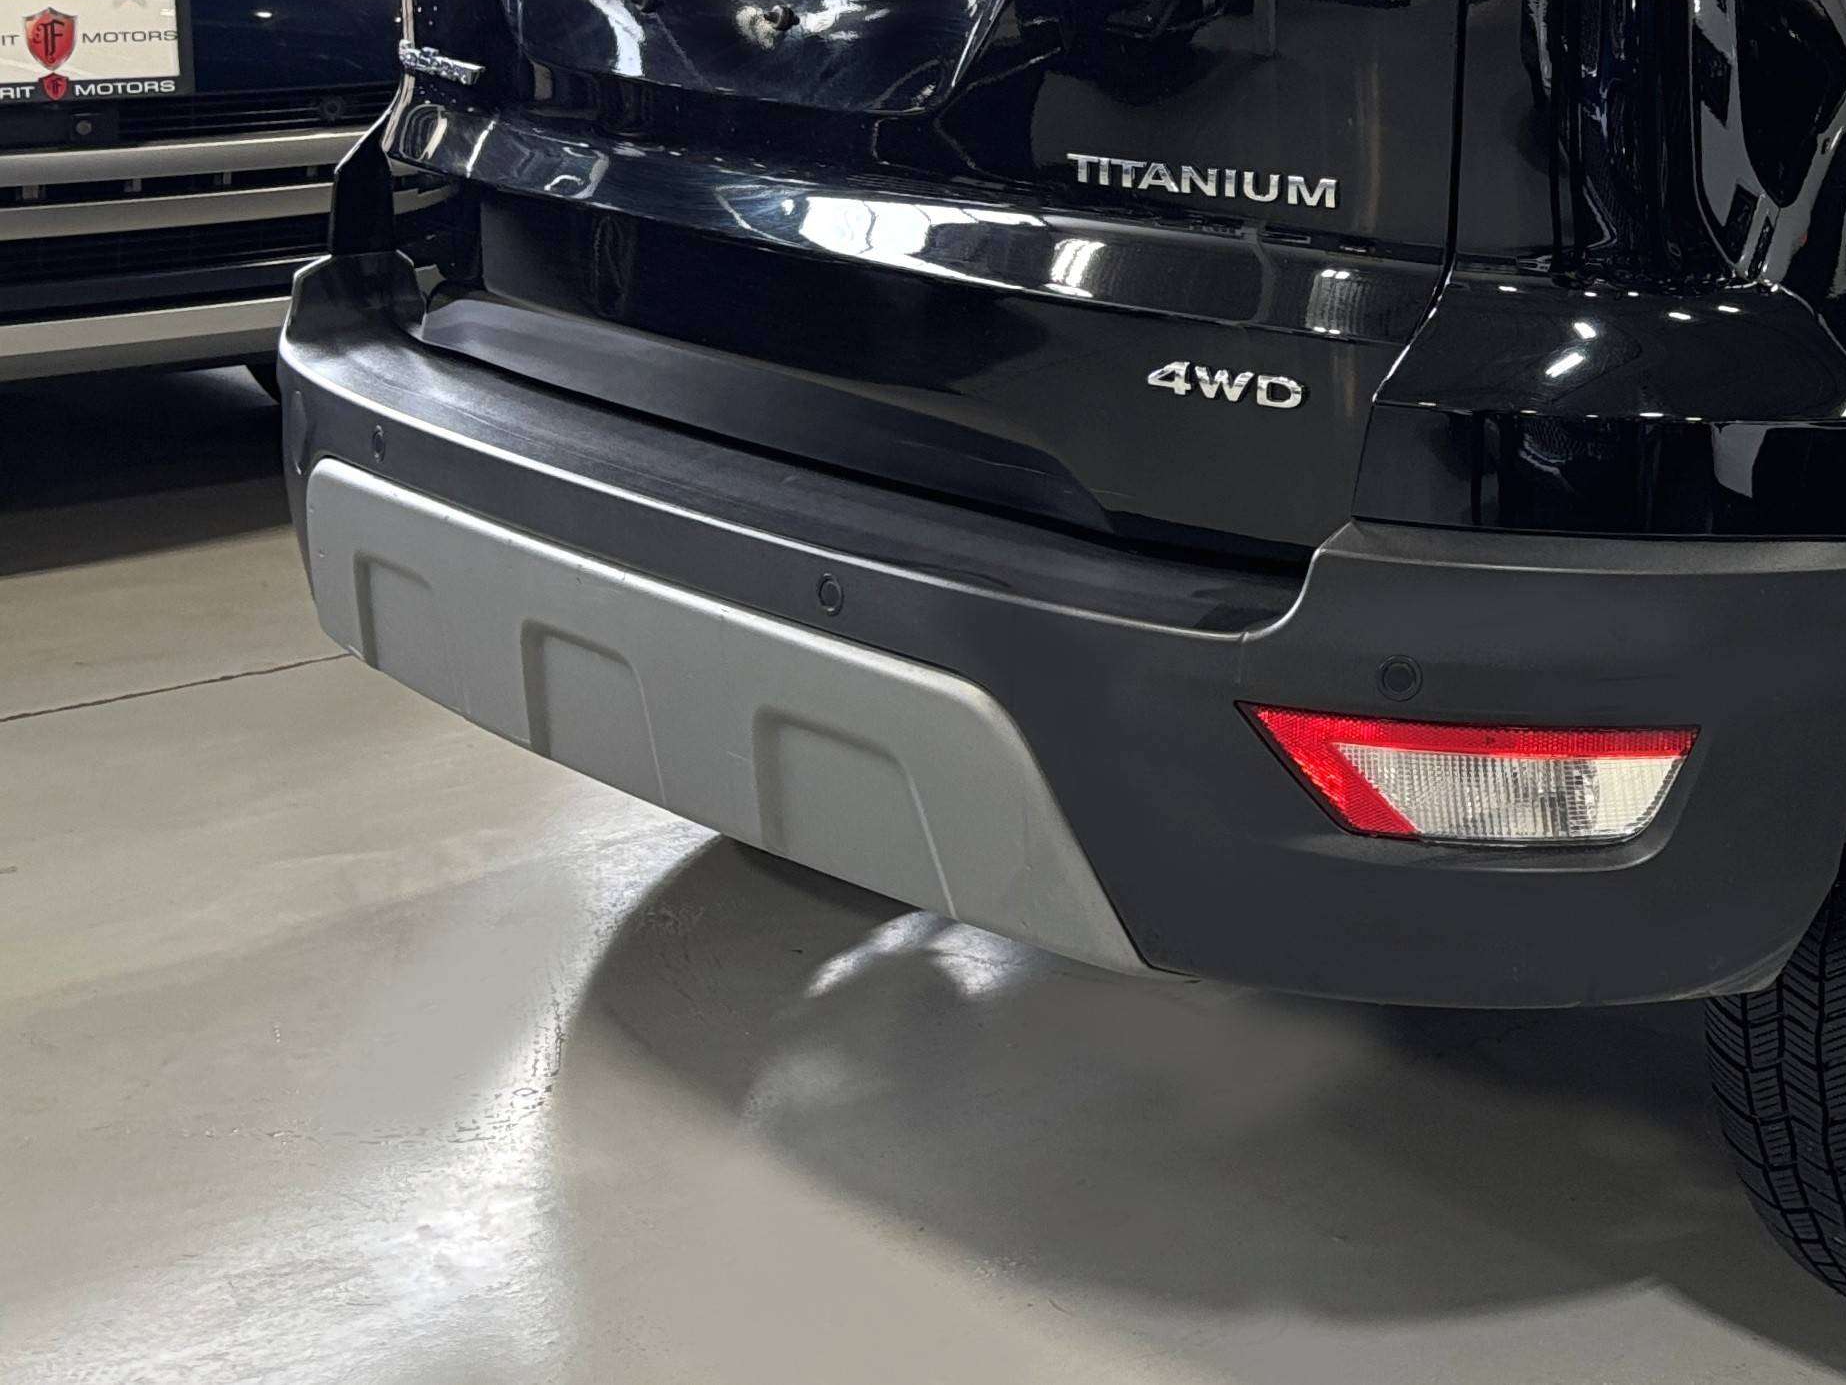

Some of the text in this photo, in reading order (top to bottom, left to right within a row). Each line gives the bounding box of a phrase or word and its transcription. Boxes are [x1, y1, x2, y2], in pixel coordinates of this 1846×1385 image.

[82, 30, 178, 44] MOTORS
[74, 79, 176, 97] MOTORS
[1066, 153, 1337, 208] TITANIUM
[1147, 361, 1304, 409] 4WD
